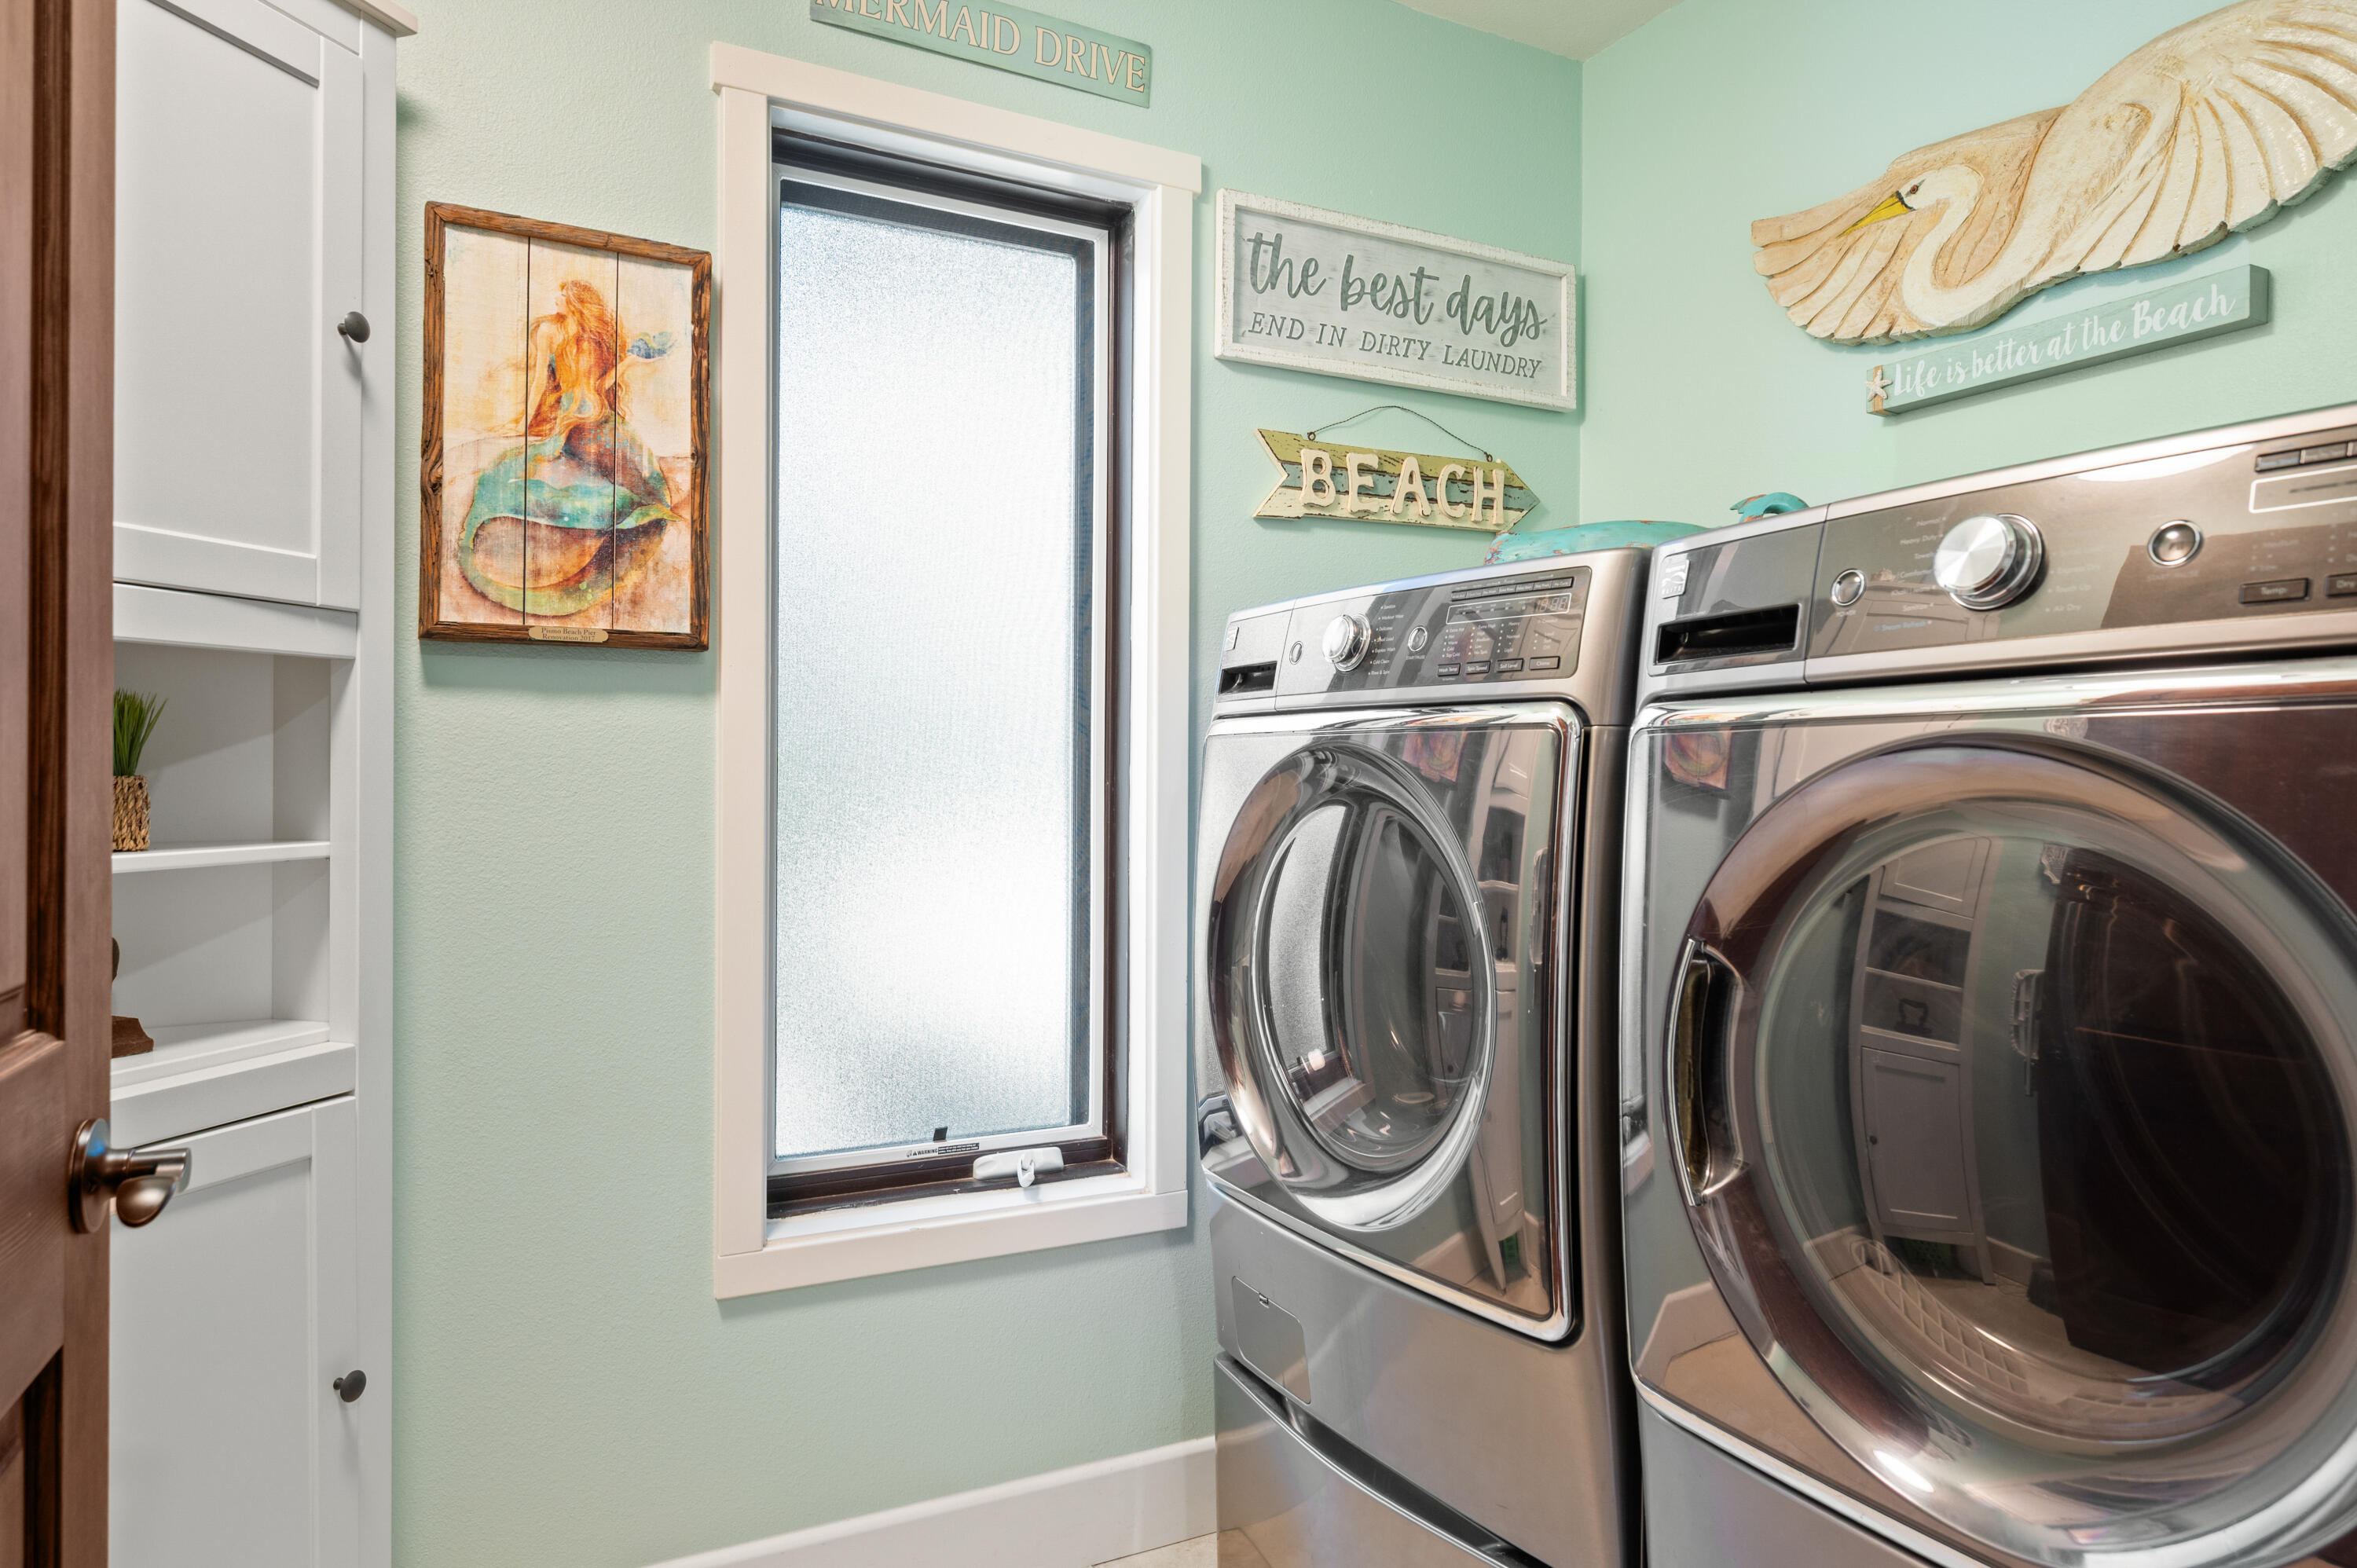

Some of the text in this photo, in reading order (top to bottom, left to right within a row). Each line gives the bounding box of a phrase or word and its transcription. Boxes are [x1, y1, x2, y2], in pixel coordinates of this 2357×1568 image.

[815, 0, 1146, 93] RMAID DRIVE
[1247, 232, 1548, 347] the best days
[1248, 312, 1542, 379] END IN DIRTY LAUNDRY
[1893, 284, 2236, 397] Life is better at the Beach
[1299, 449, 1505, 526] BEACH
